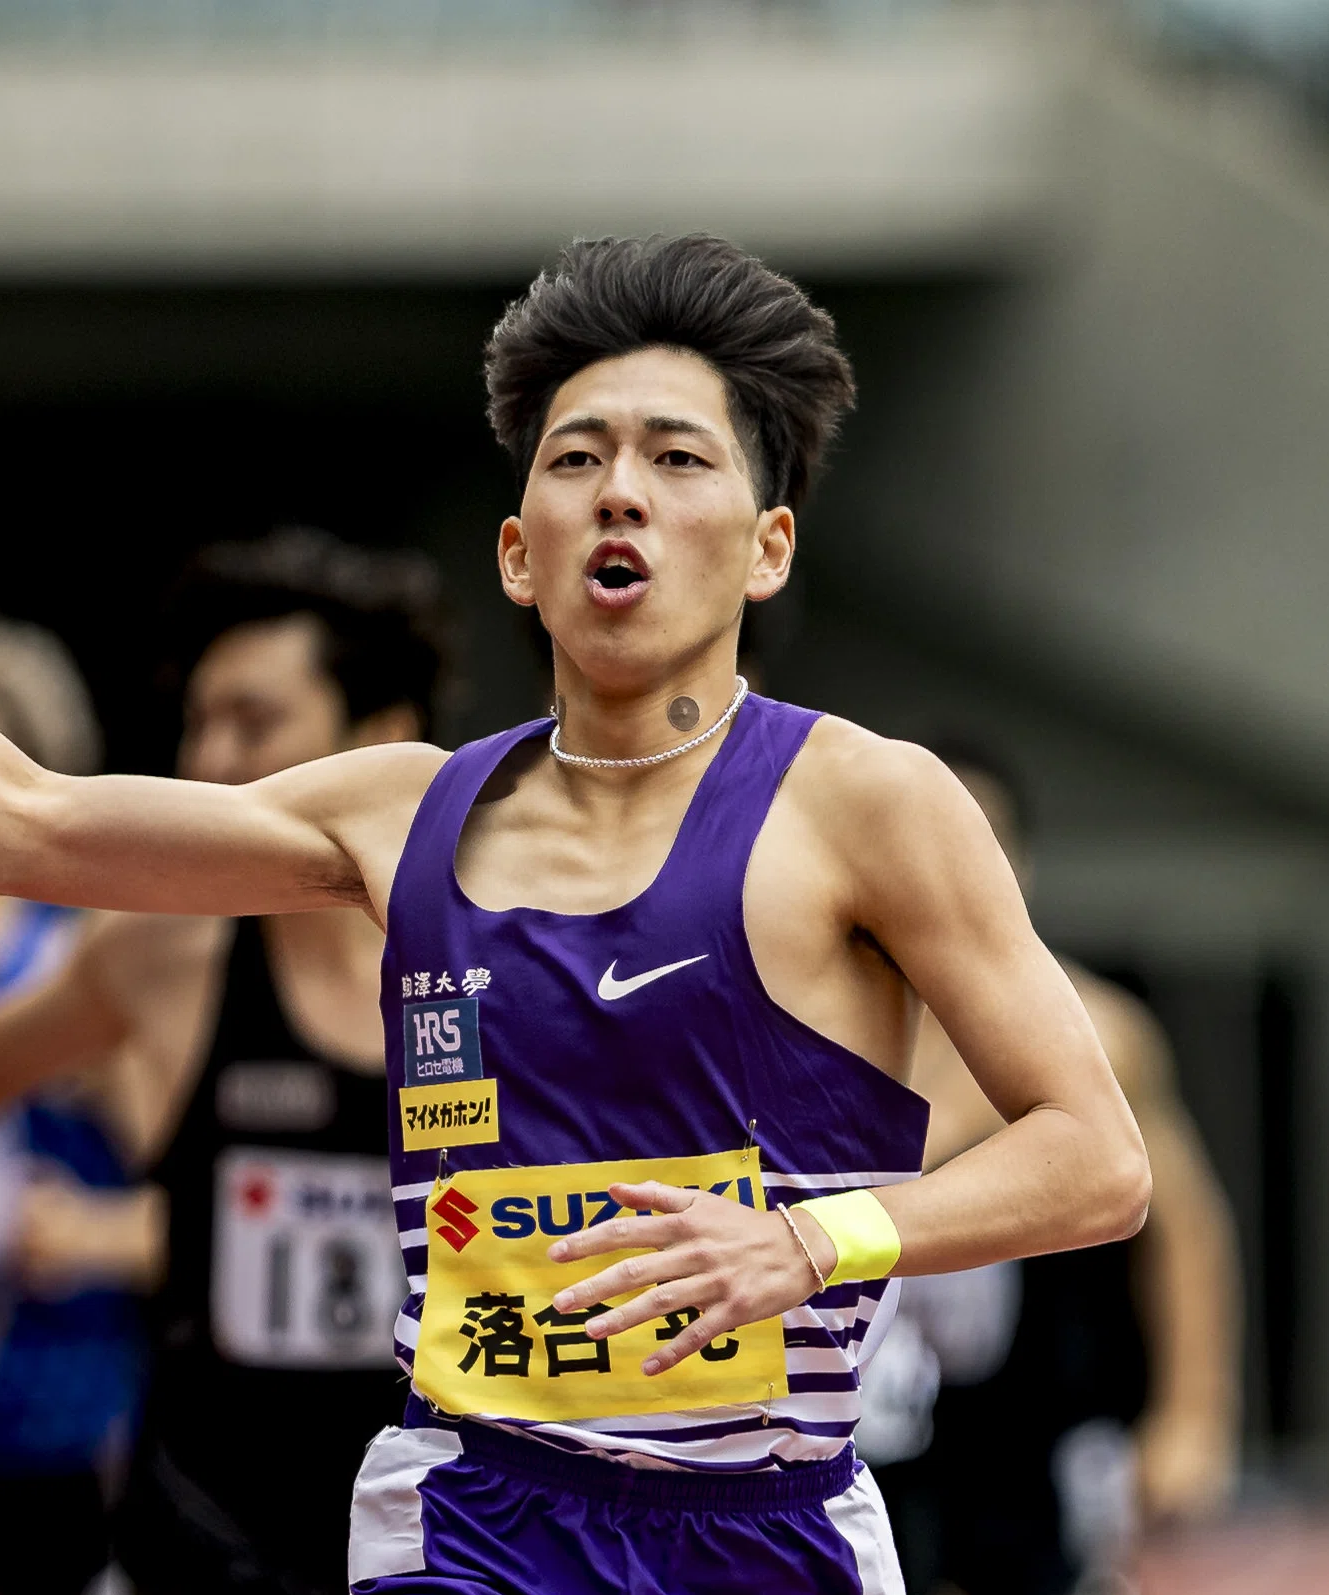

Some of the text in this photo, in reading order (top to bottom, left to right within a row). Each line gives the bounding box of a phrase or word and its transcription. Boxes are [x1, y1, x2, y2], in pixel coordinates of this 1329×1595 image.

[413, 1009, 461, 1056] HRS
[416, 1056, 465, 1077] ヒロセ電機
[405, 1097, 491, 1131] マイメガホン!
[265, 1230, 377, 1342] 18
